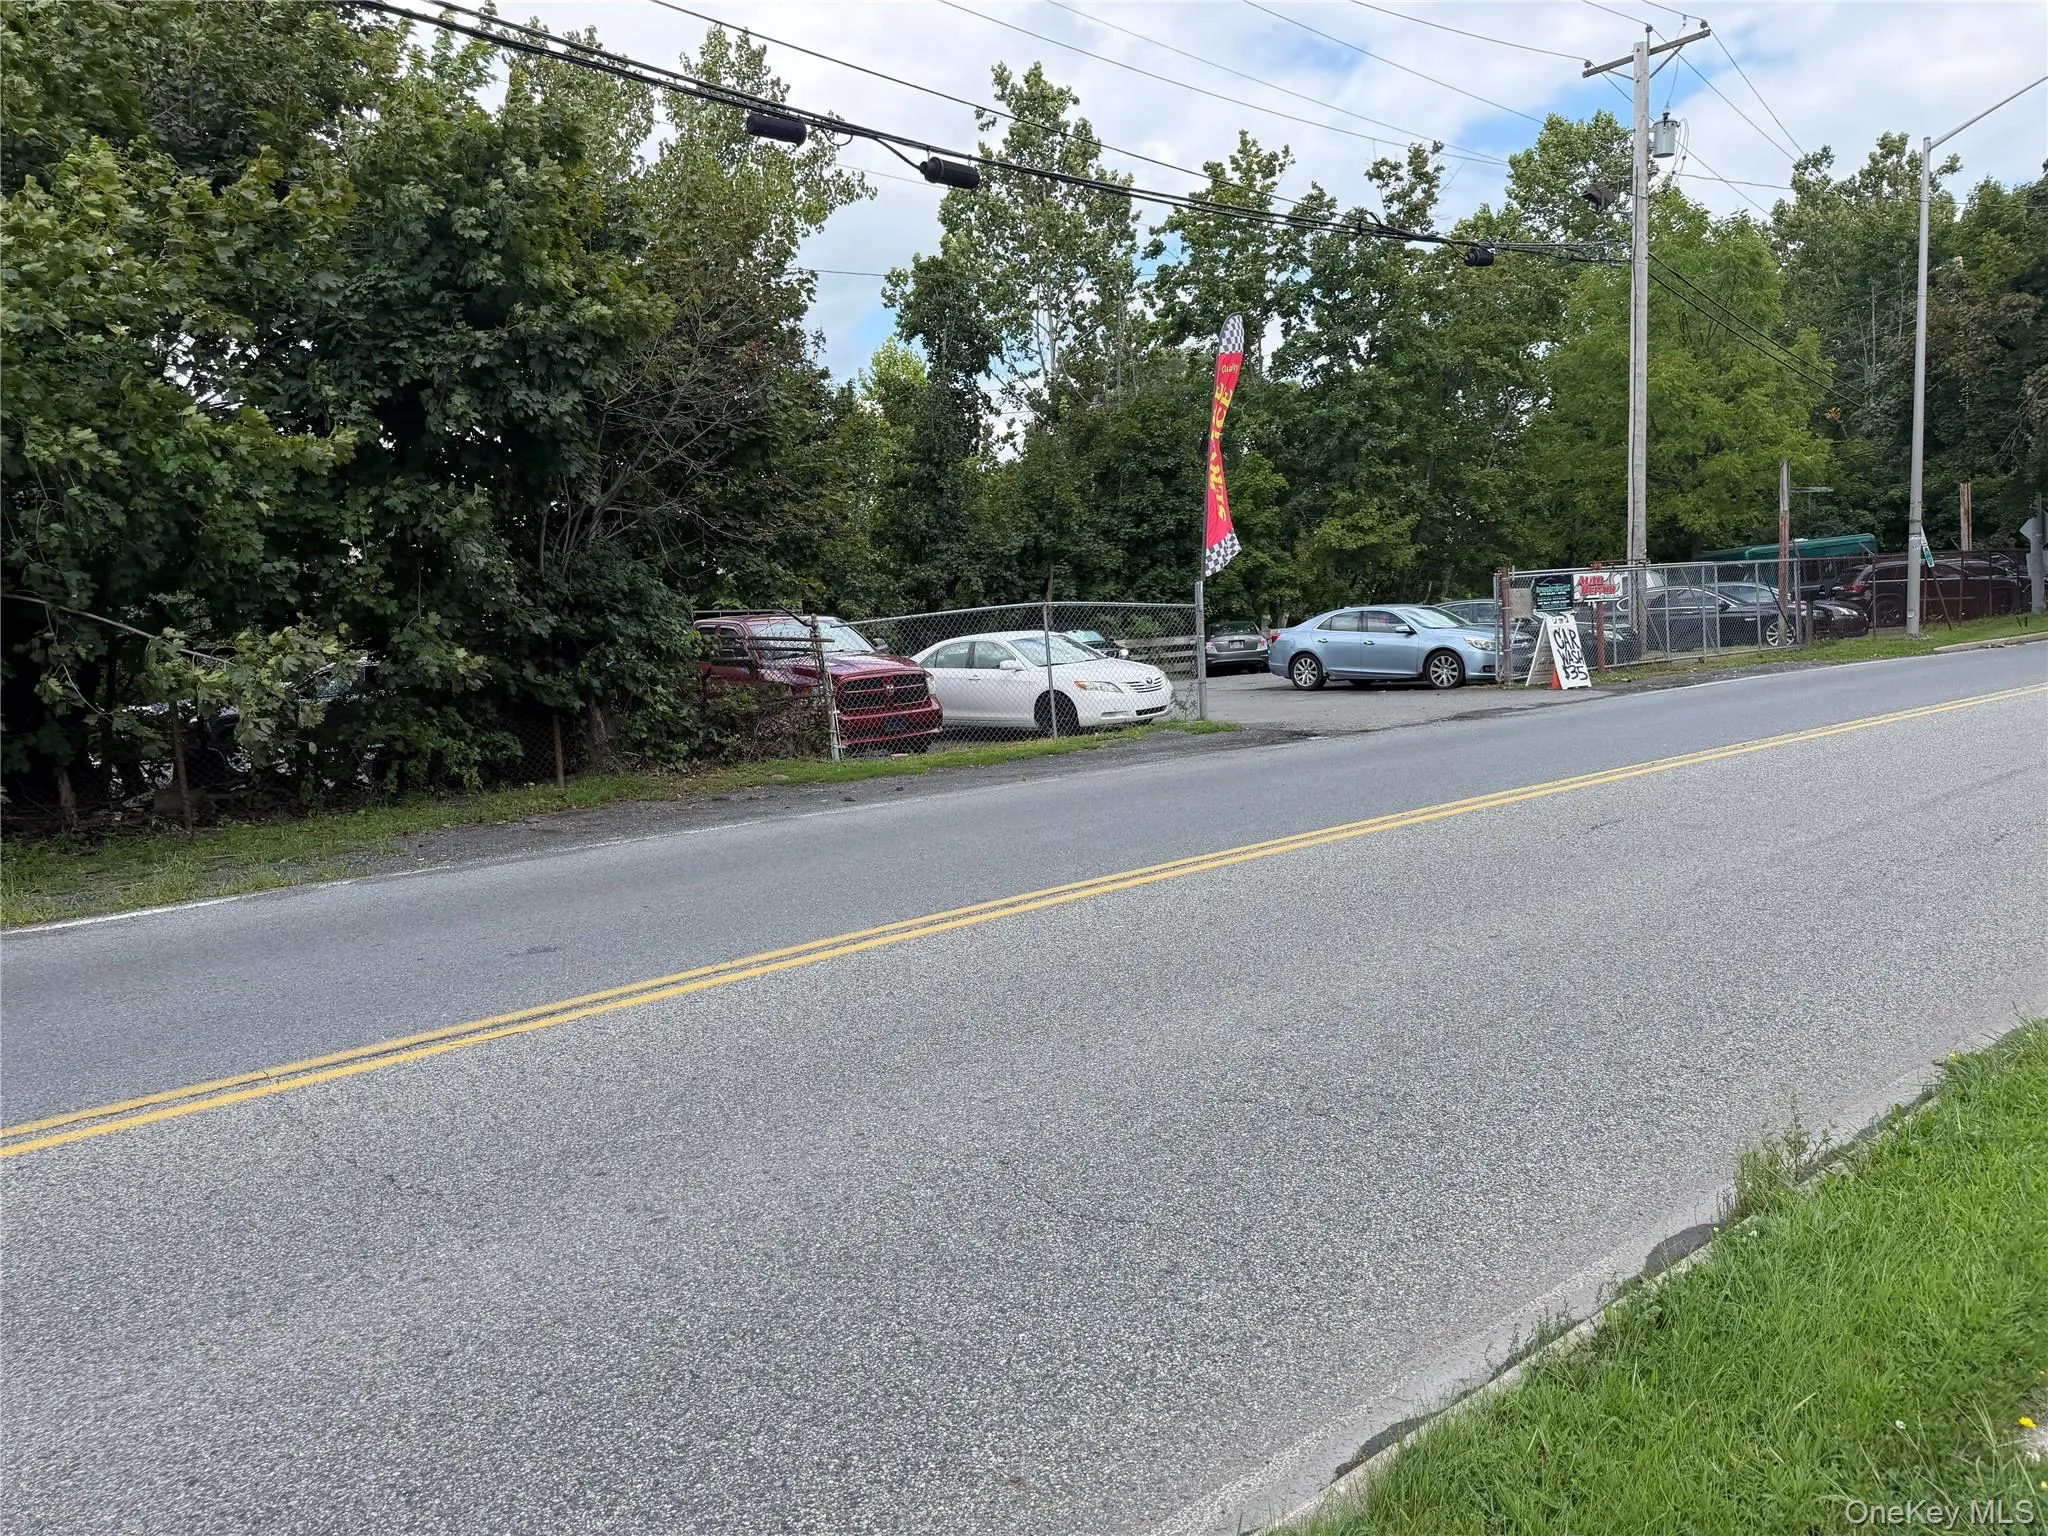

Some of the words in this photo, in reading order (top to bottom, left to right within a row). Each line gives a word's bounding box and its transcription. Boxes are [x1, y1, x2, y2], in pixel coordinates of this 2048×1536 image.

[1553, 628, 1580, 650] CAR
[1557, 649, 1585, 666] WASH
[1562, 665, 1589, 681] $35
